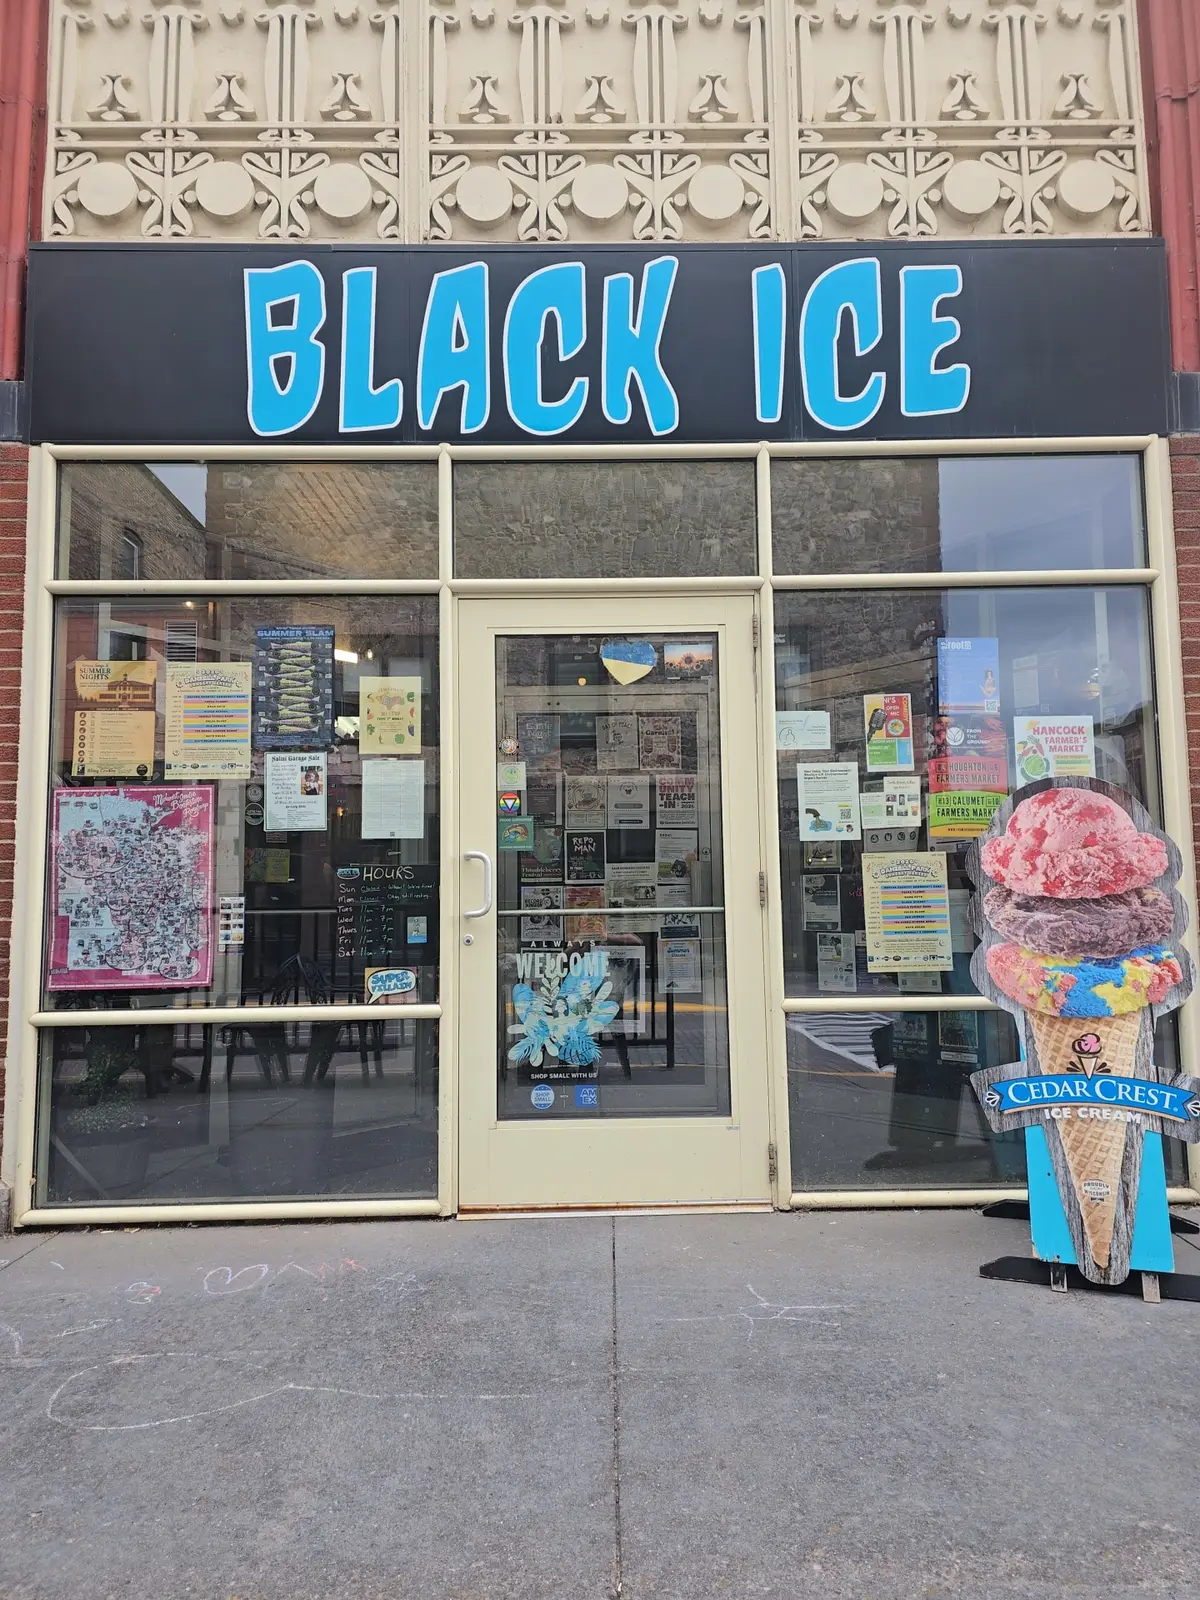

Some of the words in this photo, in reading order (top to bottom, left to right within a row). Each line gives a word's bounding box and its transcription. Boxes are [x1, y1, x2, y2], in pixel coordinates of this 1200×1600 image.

[243, 255, 680, 437] BLACK
[751, 256, 971, 431] ICE
[1032, 725, 1085, 735] HANCOCK
[1045, 736, 1088, 744] FARMER'S
[949, 762, 987, 772] HOUGHTON
[659, 777, 695, 786] COMM
[936, 774, 969, 783] FARMERS
[971, 774, 1000, 784] MARKET
[659, 785, 693, 793] UNITY
[658, 793, 695, 801] TEACH
[952, 796, 985, 806] CALUMET
[936, 807, 970, 817] FARMERS
[972, 808, 996, 817] MARKE
[572, 836, 594, 845] REPO
[574, 842, 596, 854] MAN
[363, 866, 414, 881] HOURS
[339, 883, 356, 893] Sun
[338, 895, 355, 903] Mon
[337, 905, 353, 913] Tues
[337, 916, 354, 924] Wed
[338, 926, 358, 935] Thurs
[338, 936, 352, 945] Fri
[530, 939, 596, 948] ALWAYS
[338, 946, 356, 958] Sat
[515, 951, 611, 979] WELCOME
[371, 970, 411, 985] SUPER
[371, 981, 413, 992] VILLAIN
[581, 1088, 597, 1096] AM
[1008, 1082, 1090, 1103] CEDAR
[1094, 1079, 1178, 1110] CREST
[582, 1096, 598, 1104] EX
[1044, 1107, 1072, 1120] ICE
[1077, 1107, 1141, 1124] CREAM
[1084, 1181, 1110, 1189] PROUDLY
[1084, 1189, 1110, 1197] WISCONSIN
